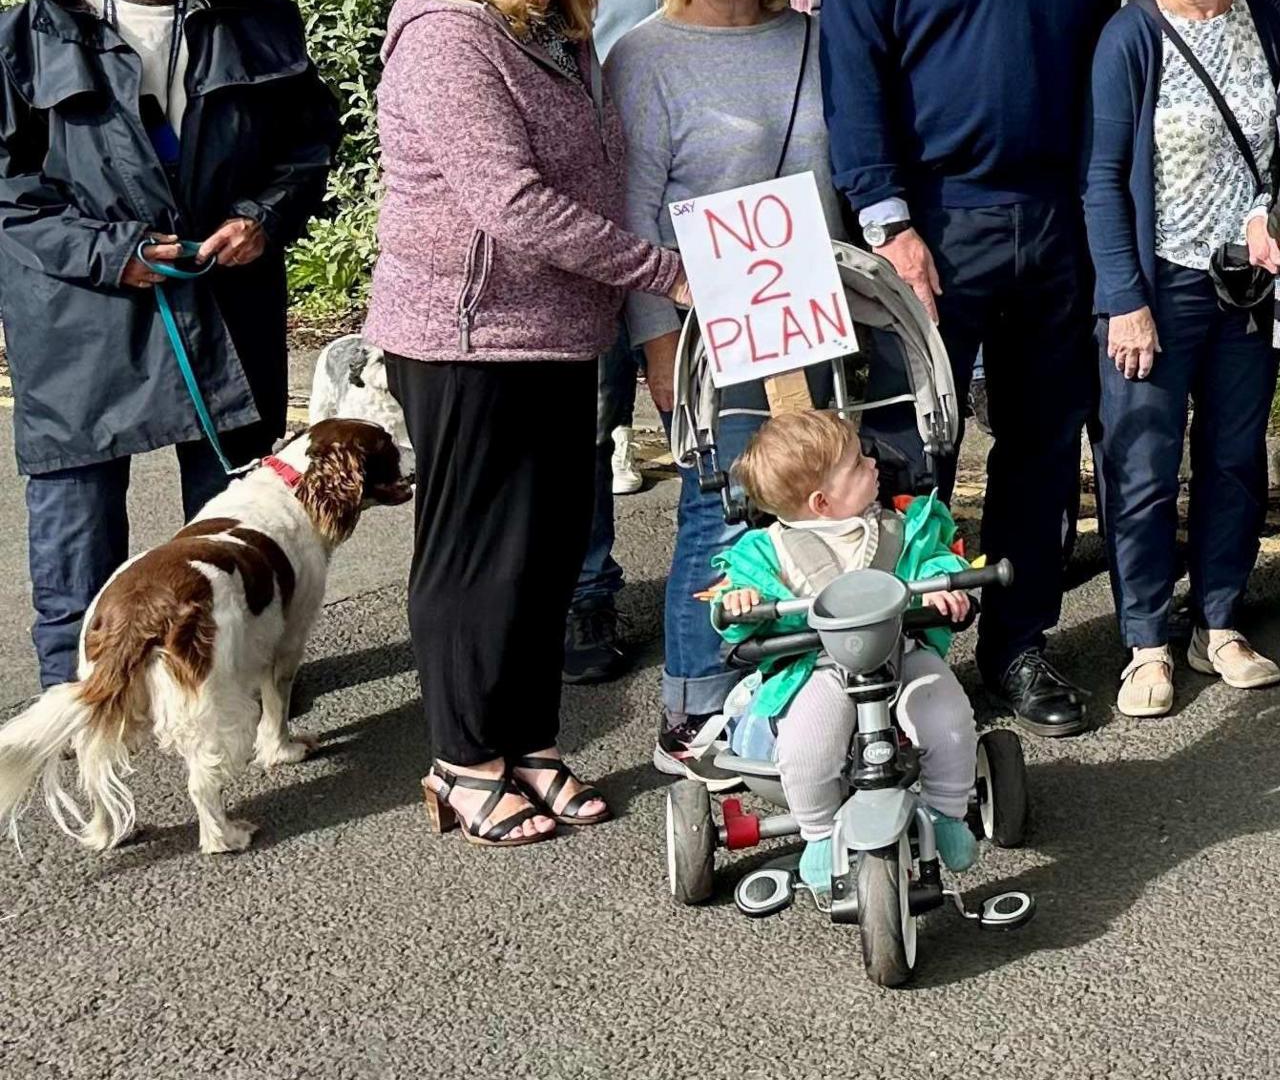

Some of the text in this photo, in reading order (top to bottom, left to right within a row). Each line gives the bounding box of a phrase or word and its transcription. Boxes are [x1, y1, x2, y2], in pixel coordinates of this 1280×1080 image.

[673, 200, 695, 217] SAY
[703, 194, 793, 260] NO
[746, 259, 791, 306] 2
[706, 292, 848, 373] PLAN
